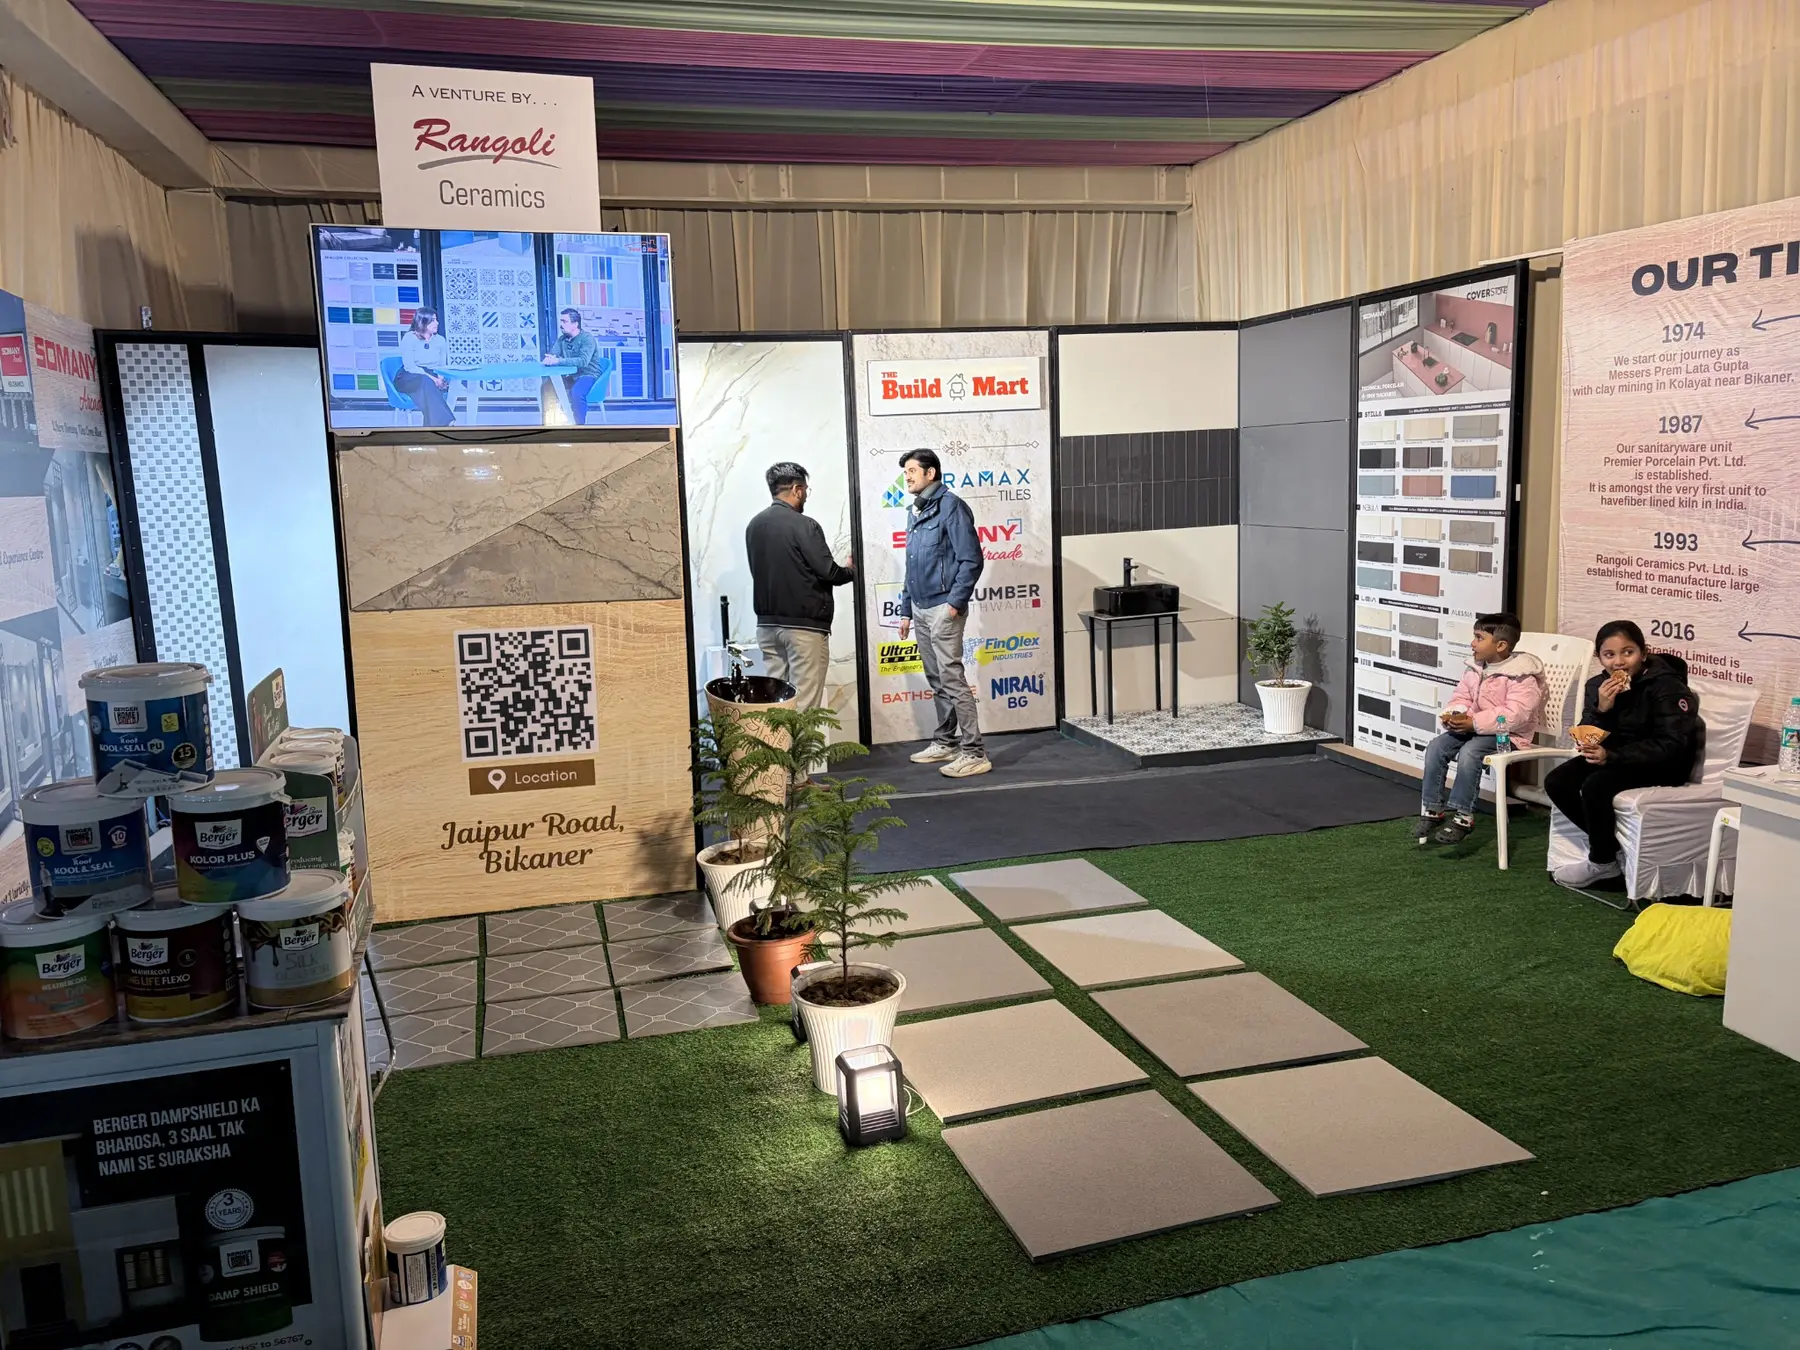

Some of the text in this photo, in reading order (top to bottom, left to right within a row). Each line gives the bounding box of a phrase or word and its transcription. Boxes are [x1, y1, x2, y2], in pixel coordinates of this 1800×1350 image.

[411, 84, 425, 98] A
[429, 87, 506, 103] VENTURE
[412, 118, 556, 164] Rangoli
[439, 180, 546, 209] Ceramics
[1631, 240, 1800, 297] OUR TI
[1661, 321, 1706, 344] 1974
[1614, 346, 1740, 367] We start our journey as
[1608, 359, 1749, 381] Messers Prem Lata Gupta
[881, 371, 1029, 400] THE Build Mart
[1572, 371, 1795, 397] with clay mining in Kolayat near Bikaner.
[1658, 414, 1703, 434] 1987
[1616, 441, 1733, 456] Our sanitaryware unit
[1603, 456, 1747, 467] Premier Porcelain Pvt. Ltd.
[943, 468, 1031, 489] RAMAX
[1634, 469, 1712, 481] is established.
[998, 489, 1032, 502] TILES
[1589, 482, 1767, 498] It is amongst the very first unit to
[1649, 496, 1675, 508] lined
[1678, 496, 1699, 508] kiln
[1701, 498, 1712, 509] in
[1715, 498, 1748, 511] India.
[1653, 531, 1699, 552] 1993
[981, 544, 1024, 562] rcade
[1596, 554, 1749, 577] Rangoli Ceramics Pvt. Ltd. is
[1586, 566, 1760, 595] established to manufacture large
[1615, 580, 1723, 603] format ceramic tiles.
[1650, 619, 1695, 642] 2016
[993, 651, 1033, 661] INDUSTRIES
[1685, 650, 1727, 668] Limited
[1729, 656, 1741, 669] is
[1687, 664, 1754, 685] uble-salt tile
[1008, 696, 1028, 709] BG
[125, 743, 147, 753] SEAL
[178, 746, 192, 759] 15
[514, 769, 578, 786] Location
[284, 811, 323, 830] erger
[440, 805, 625, 853] Jaipur Road,
[113, 832, 126, 841] 10
[200, 831, 238, 845] Berger
[189, 851, 256, 865] KOLOR PLUS
[478, 845, 593, 874] Bikaner
[54, 867, 80, 876] KOOL
[90, 861, 115, 871] SEAL
[284, 933, 316, 946] Berger
[131, 948, 164, 962] Berger
[42, 958, 82, 974] Berger
[141, 976, 161, 986] LIFE
[162, 973, 191, 986] FLEXO
[93, 1096, 261, 1135] BERGER DAMPSHIELD KA
[96, 1120, 245, 1156] BHAROSA, 3 SAAL TAK
[98, 1143, 232, 1177] NAMI SE SURAKSHA
[222, 1192, 234, 1207] 3
[218, 1206, 242, 1217] YEARS
[207, 1281, 280, 1302] DAMP SHIELD
[261, 1341, 272, 1349] to
[273, 1333, 304, 1347] 56767
